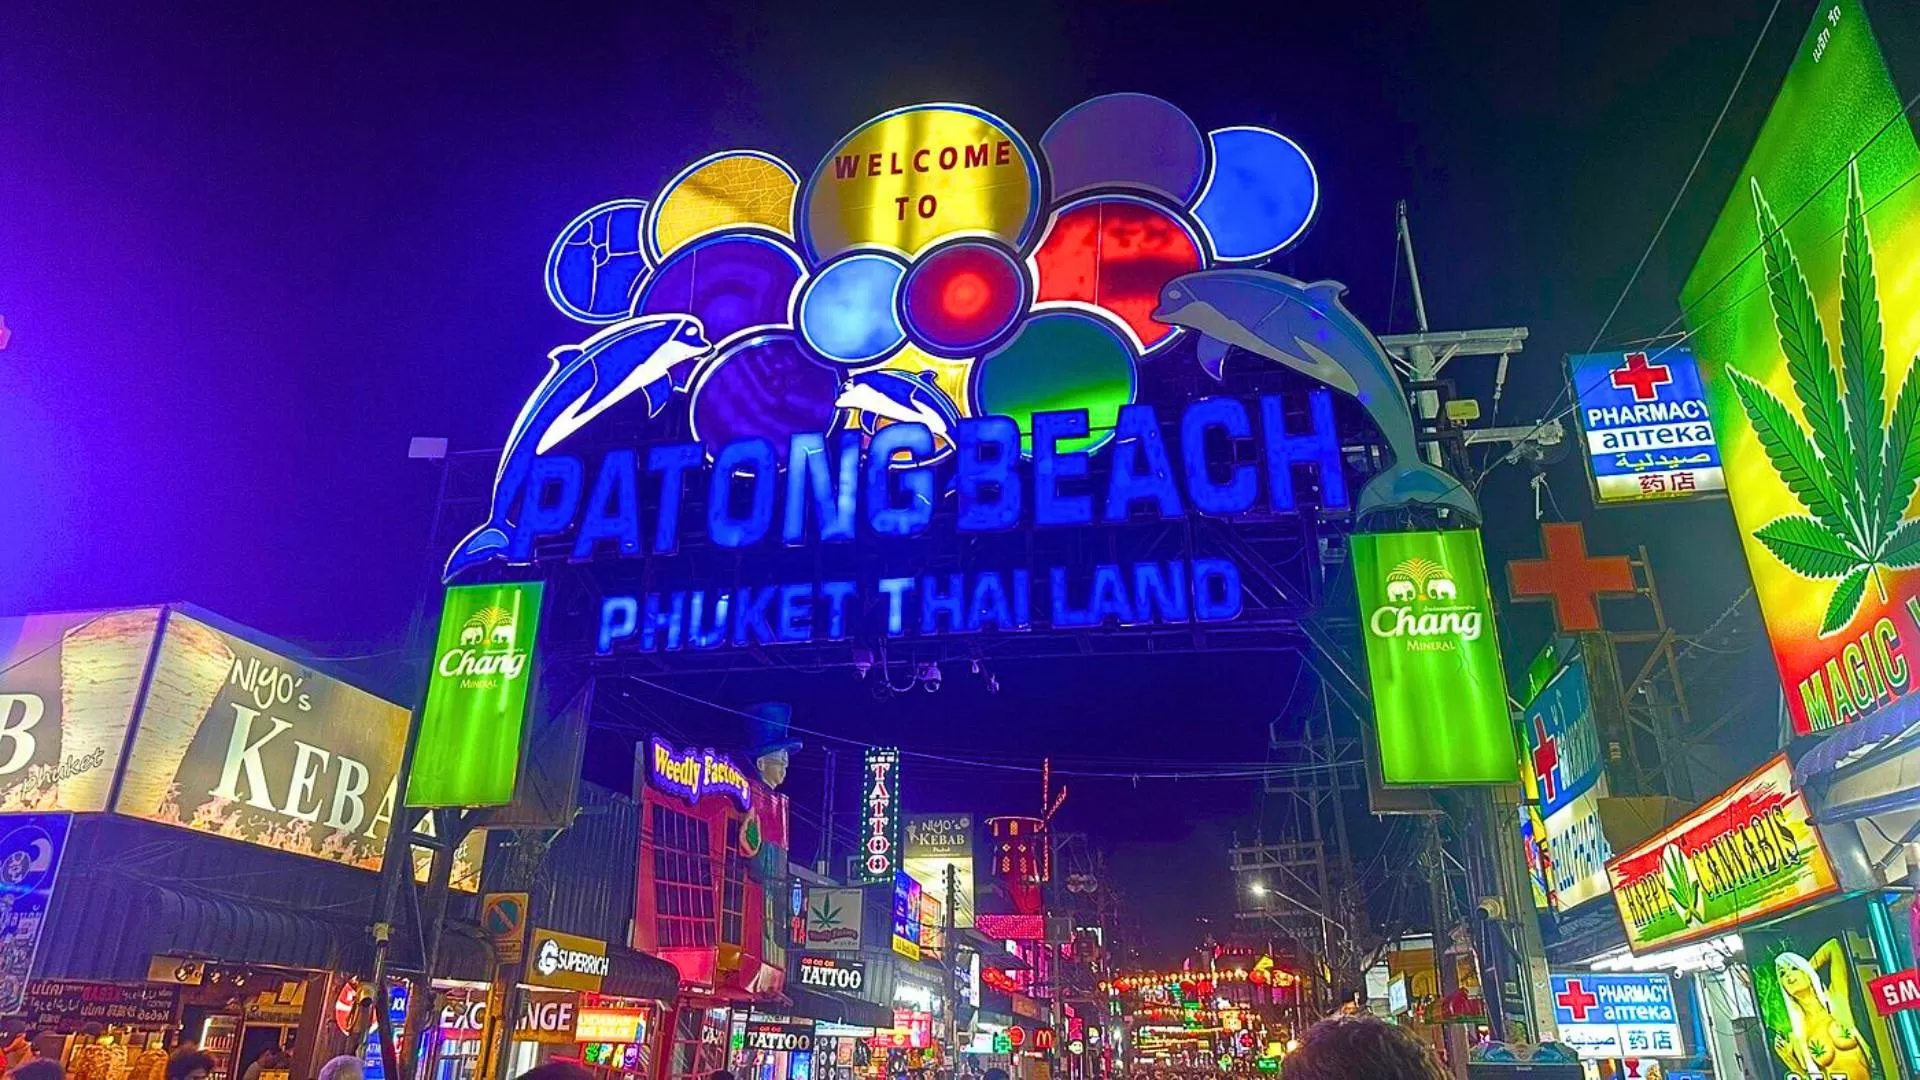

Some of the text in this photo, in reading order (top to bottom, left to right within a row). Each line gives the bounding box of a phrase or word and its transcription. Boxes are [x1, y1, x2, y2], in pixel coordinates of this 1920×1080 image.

[834, 140, 1012, 180] WELCOME
[895, 194, 938, 221] TO
[1588, 400, 1710, 427] PHARMACY
[1603, 424, 1713, 449] аптека
[1615, 452, 1712, 471] صيدلية
[508, 389, 1350, 563] PATONG BEACH
[1638, 472, 1697, 494] 药店
[596, 580, 857, 656] PHUKET
[1371, 606, 1482, 640] Chang
[439, 648, 527, 680] Chang
[1798, 617, 1909, 732] MAGIC
[20, 746, 105, 800] phuket
[654, 743, 749, 801] Weedly Factory
[866, 762, 891, 874] TATTOO
[919, 833, 965, 845] KEBAB
[1622, 857, 1676, 929] HAPPY
[1691, 803, 1800, 901] CANNABIS
[557, 949, 610, 977] SUPERRICH
[801, 965, 862, 989] TATTOO
[1599, 983, 1670, 1003] PHARMACY
[1604, 1004, 1672, 1021] аптека
[747, 1031, 810, 1050] TATTOO
[1628, 1029, 1673, 1050] 药店
